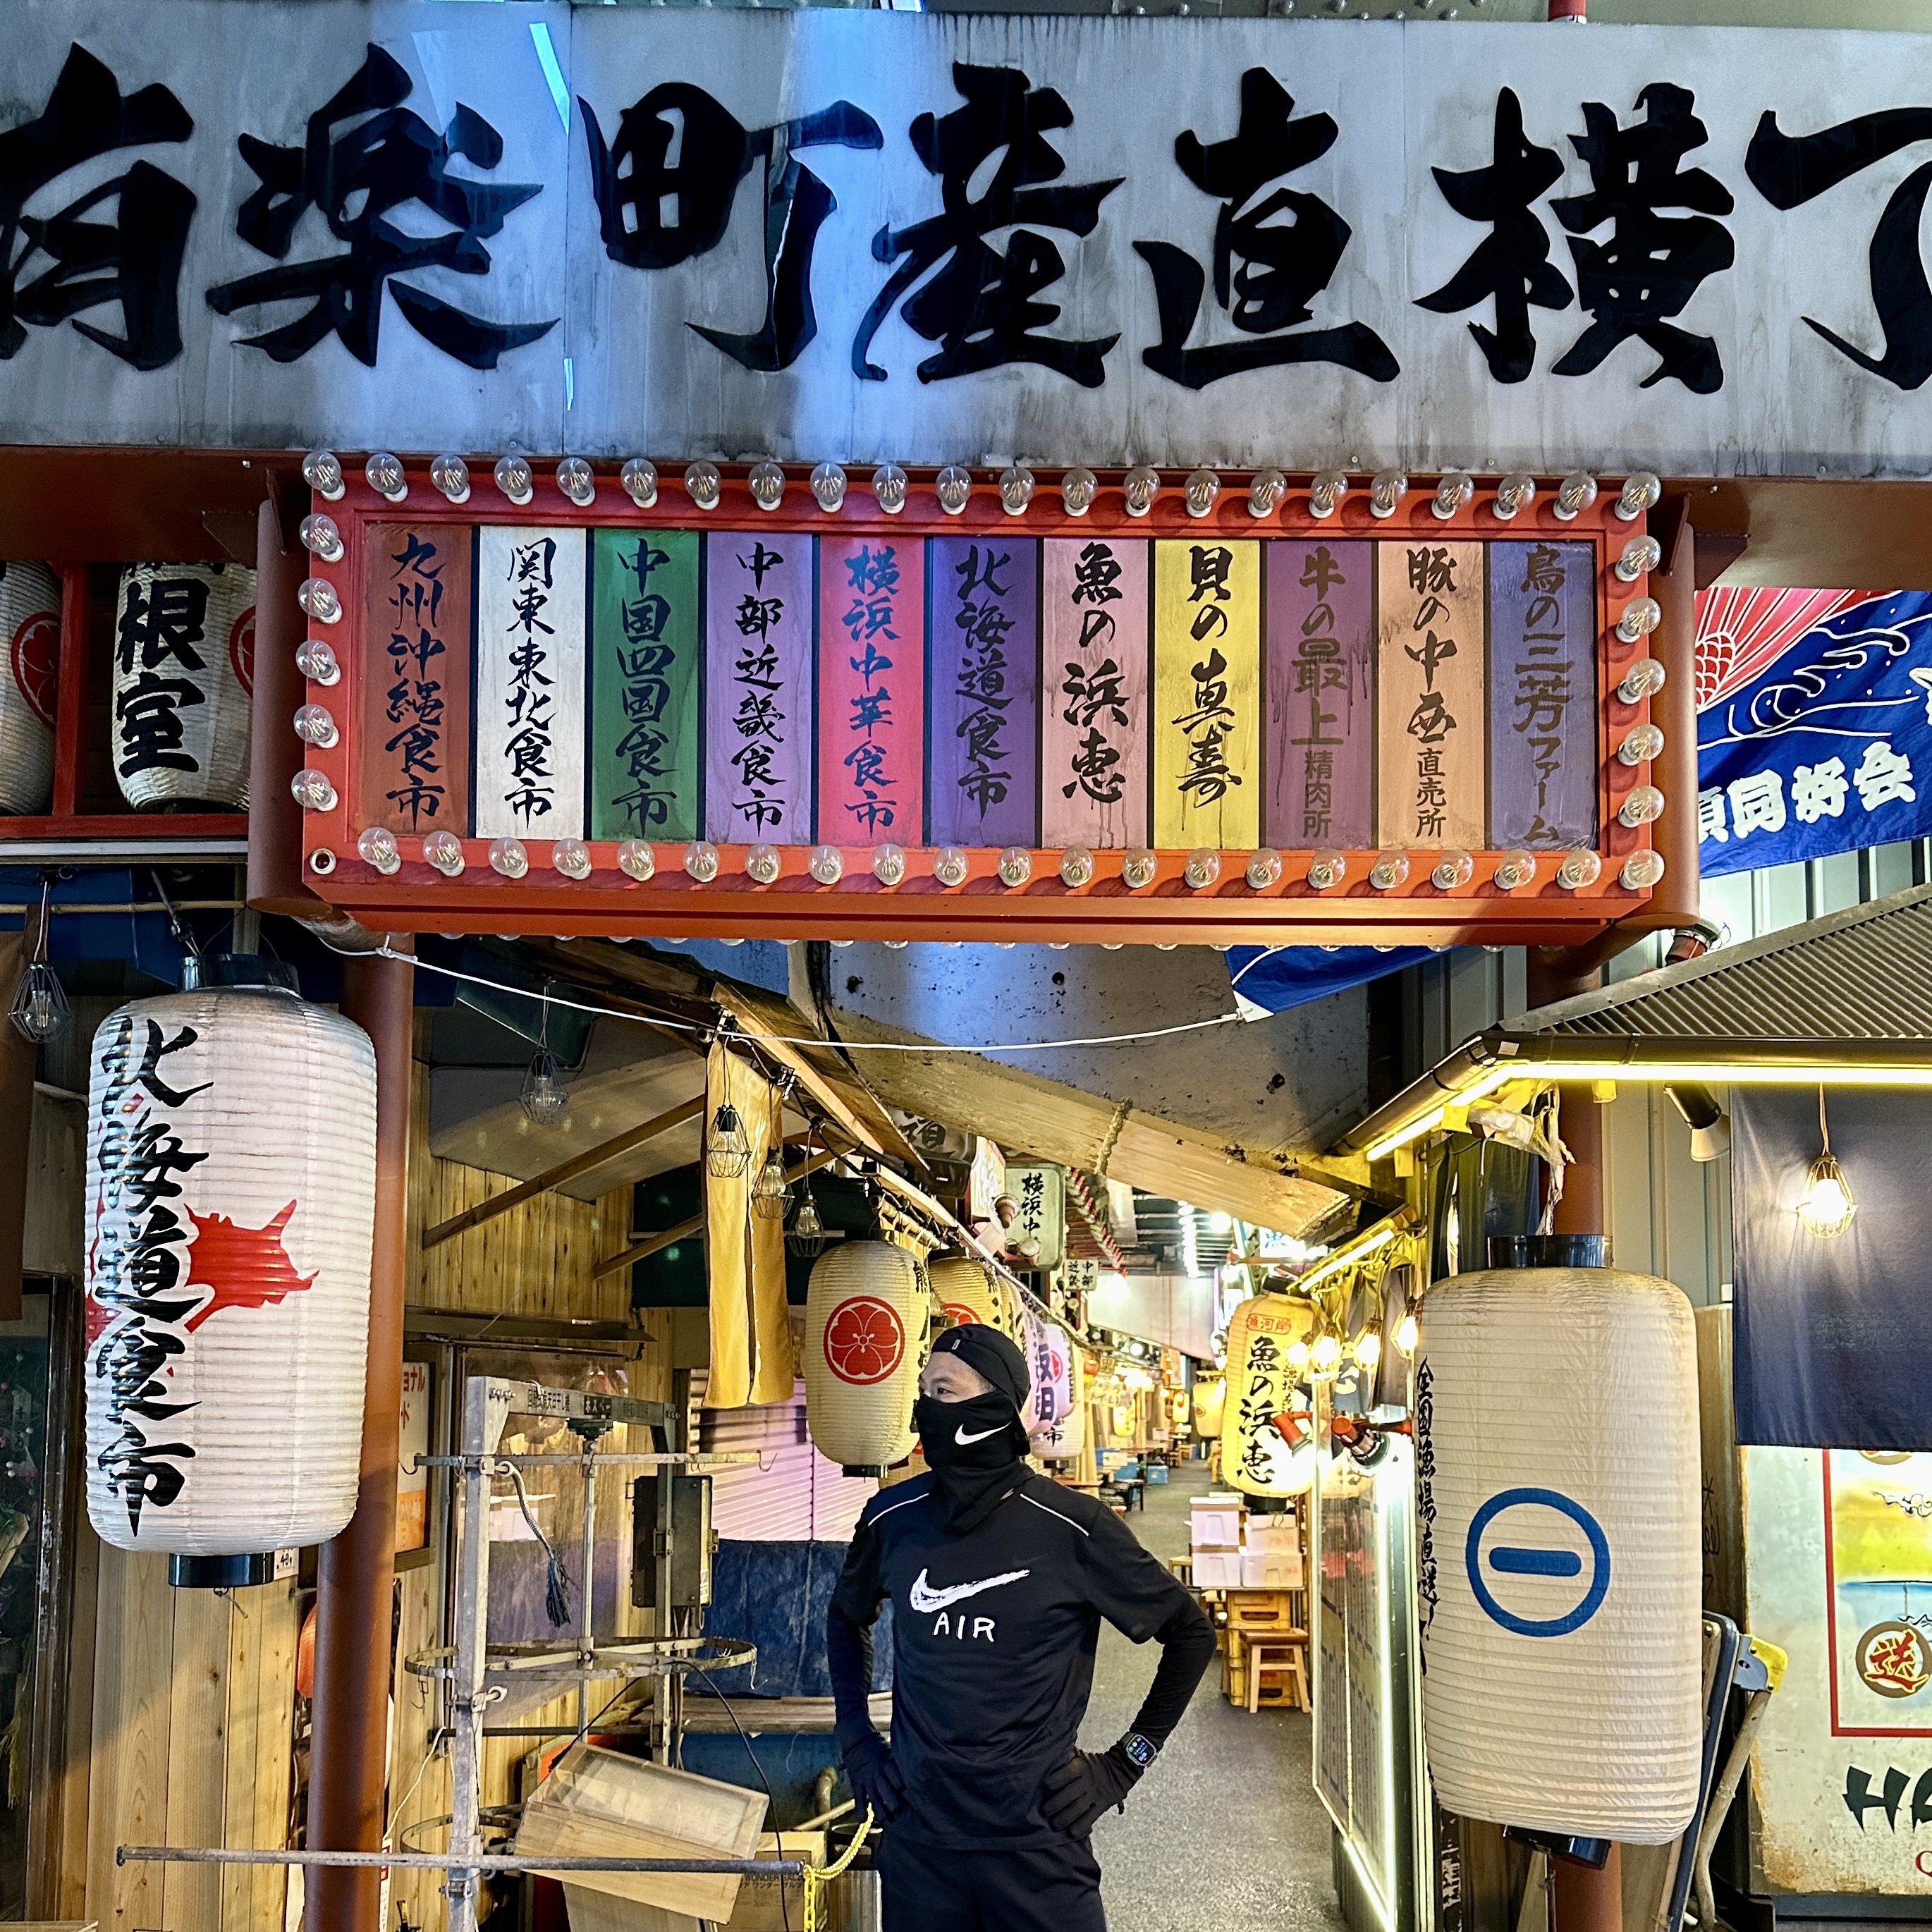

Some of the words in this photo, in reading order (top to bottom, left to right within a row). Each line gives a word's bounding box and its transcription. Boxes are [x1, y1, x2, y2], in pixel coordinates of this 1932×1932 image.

[0, 41, 1932, 392] 有楽町産直横丁
[115, 563, 211, 778] 根室
[386, 533, 447, 832] 九州沖縄食市
[504, 537, 556, 829] 関東東北食市
[612, 537, 678, 838] 中国四国食市
[730, 542, 786, 837] 中部近畿食市
[843, 544, 901, 836] 横浜中華食市
[955, 544, 1016, 822] 北海道食市
[1062, 542, 1130, 803] 魚の浜恵
[1513, 544, 1575, 842] 鳥の三芳ファーム
[1021, 1172, 1045, 1241] 横浜中
[1248, 1315, 1290, 1333] 魚河岸
[1237, 1335, 1282, 1484] 魚の浜恵
[933, 1612, 996, 1643] AIR
